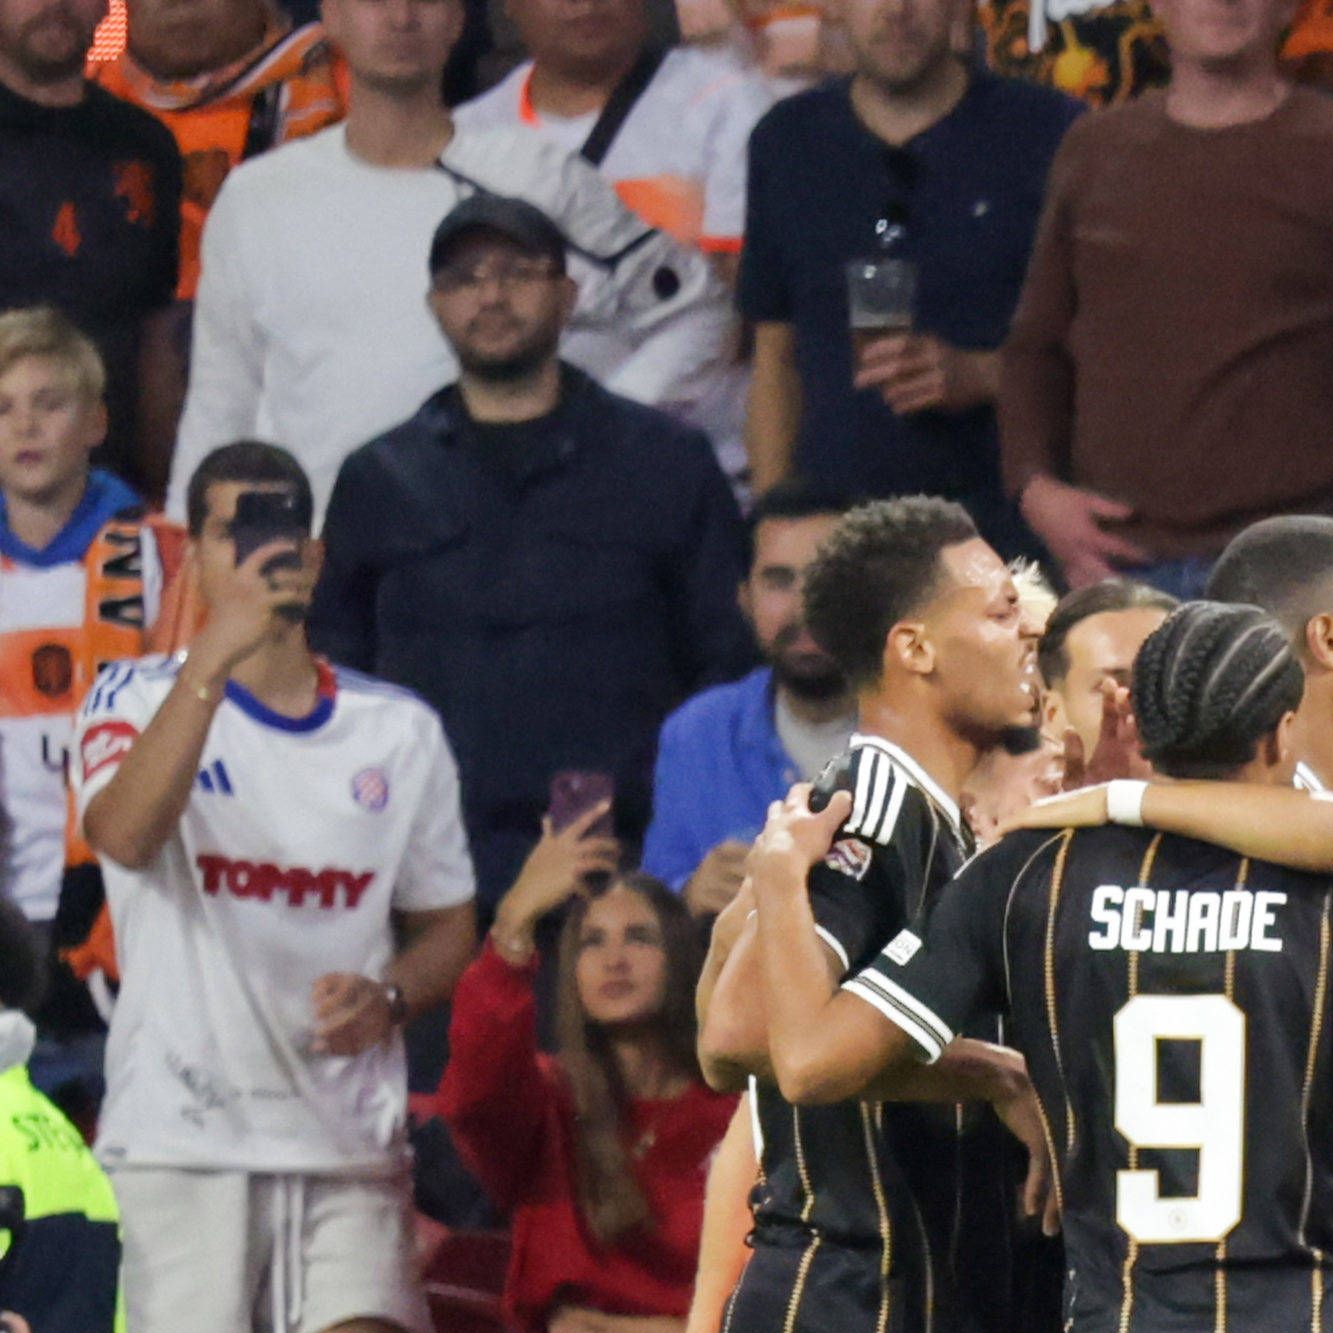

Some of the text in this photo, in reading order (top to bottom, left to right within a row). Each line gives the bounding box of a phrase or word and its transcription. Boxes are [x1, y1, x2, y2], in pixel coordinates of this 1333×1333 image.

[196, 854, 376, 911] TOMMY
[1089, 885, 1287, 953] SCHADE
[1112, 993, 1247, 1243] 9
